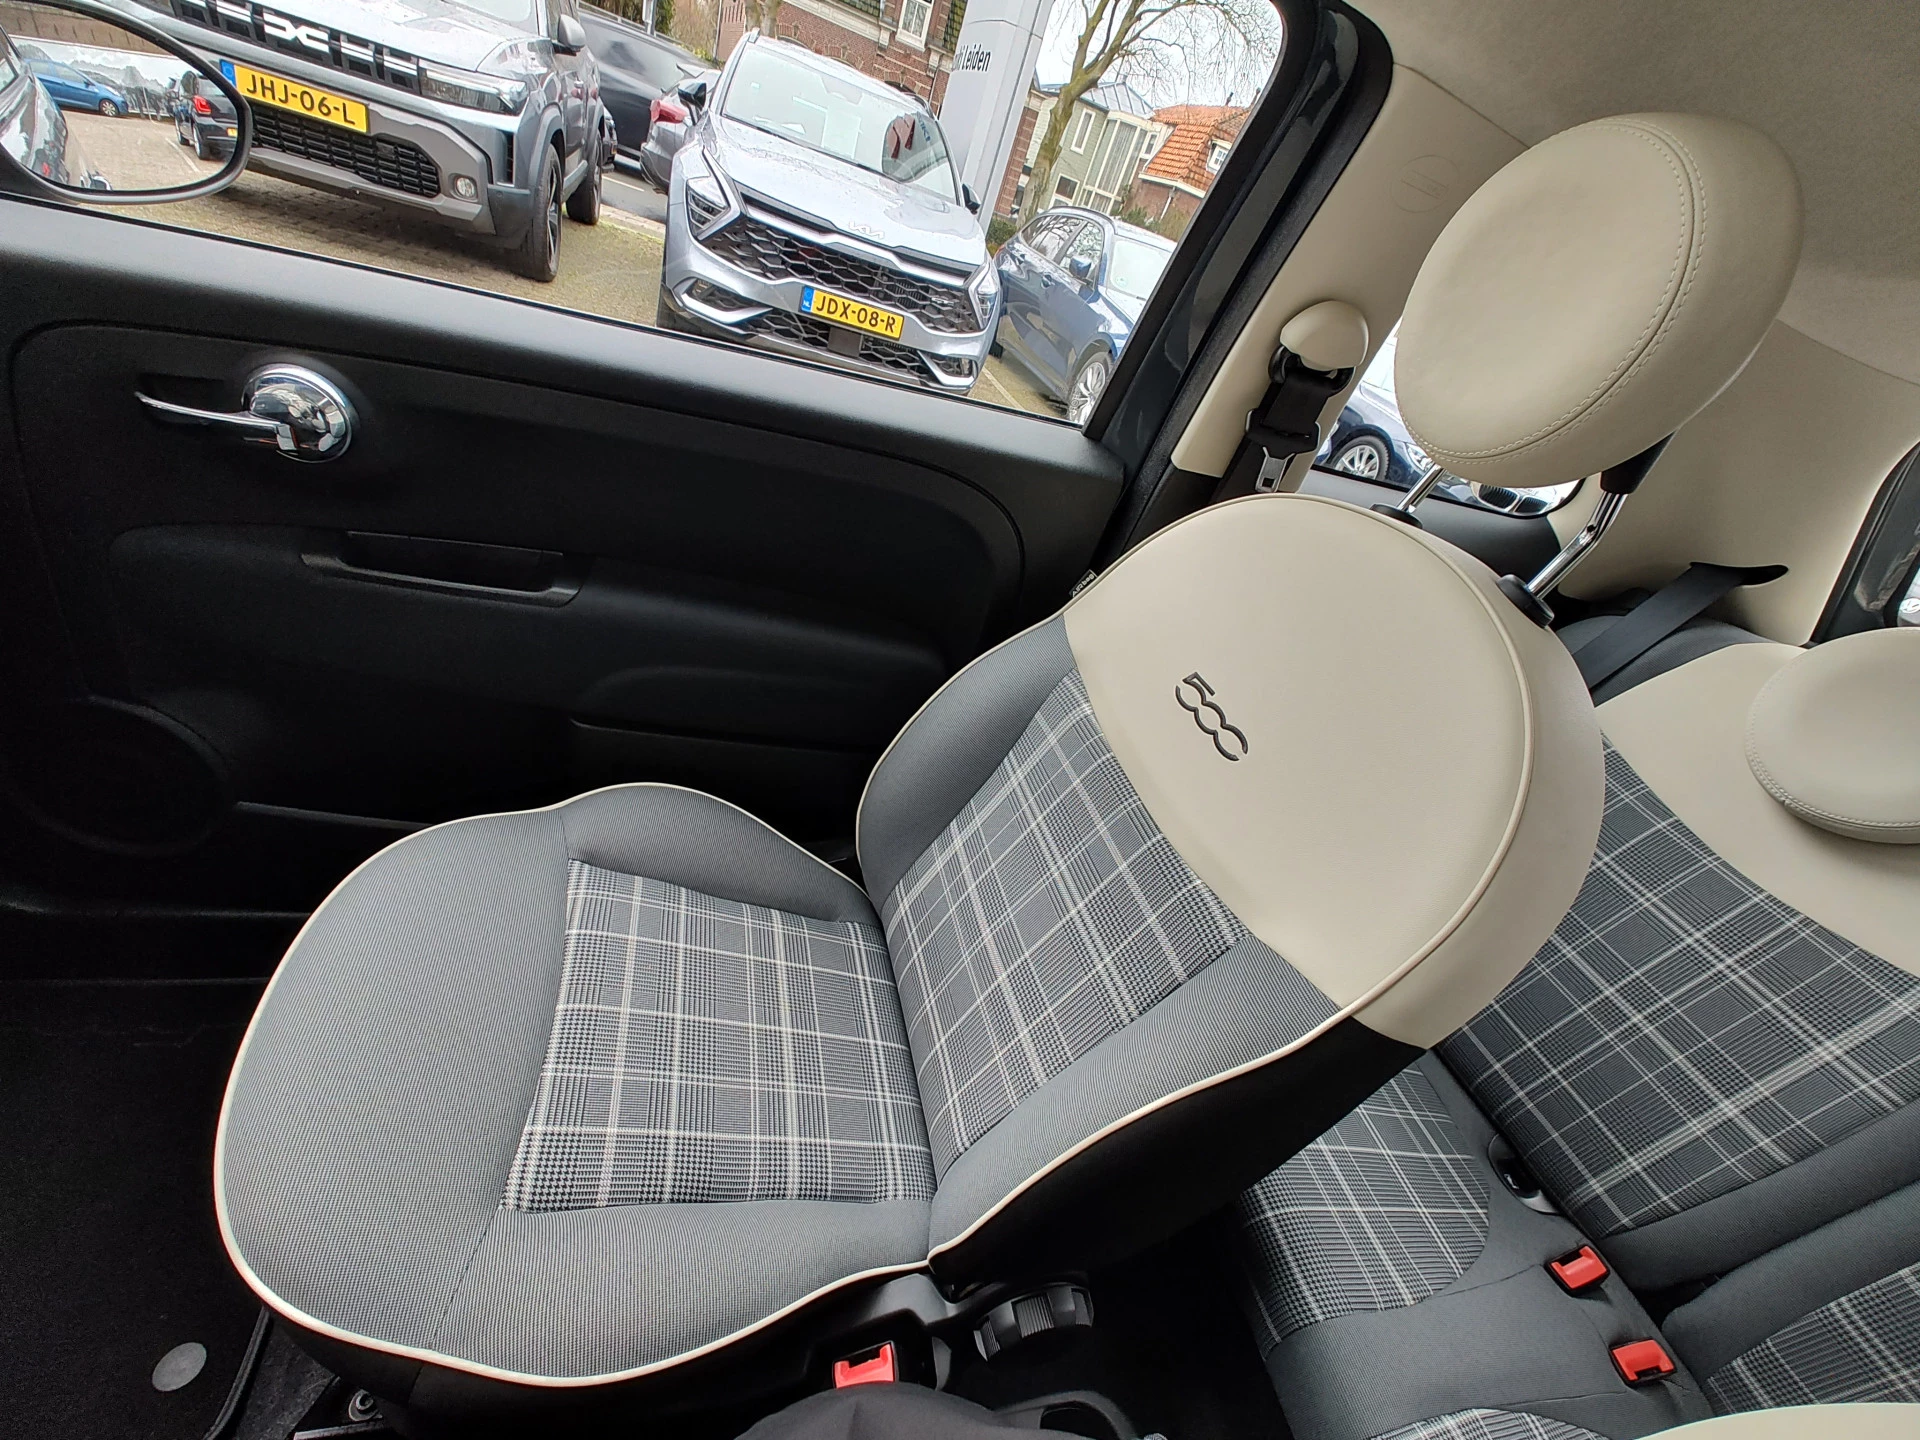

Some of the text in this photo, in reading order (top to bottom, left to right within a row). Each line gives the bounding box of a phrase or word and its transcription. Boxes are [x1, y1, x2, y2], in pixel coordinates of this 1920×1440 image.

[961, 43, 991, 72] Leiden
[246, 74, 356, 126] JHJ-06-L
[815, 295, 896, 333] JDX-08-R
[1175, 671, 1248, 762] 500
